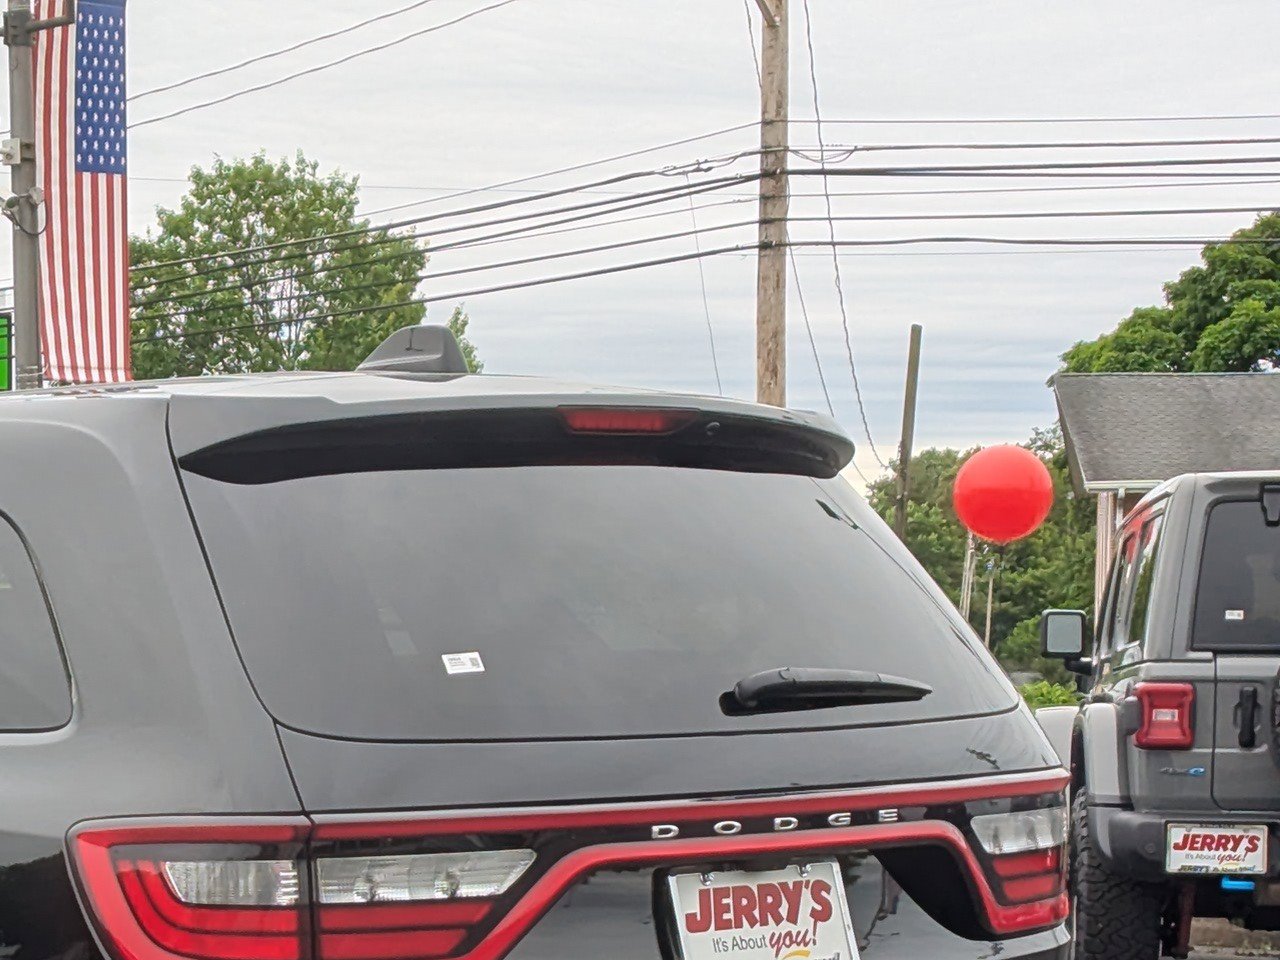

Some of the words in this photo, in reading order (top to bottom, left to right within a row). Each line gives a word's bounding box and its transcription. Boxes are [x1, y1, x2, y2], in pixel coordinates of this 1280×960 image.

[651, 808, 899, 839] DODGE
[1173, 834, 1261, 852] JERRY'S
[1217, 852, 1246, 865] you!
[685, 879, 833, 934] JERRY'S
[712, 938, 729, 953] It's
[731, 934, 768, 951] About
[769, 921, 817, 958] you!
